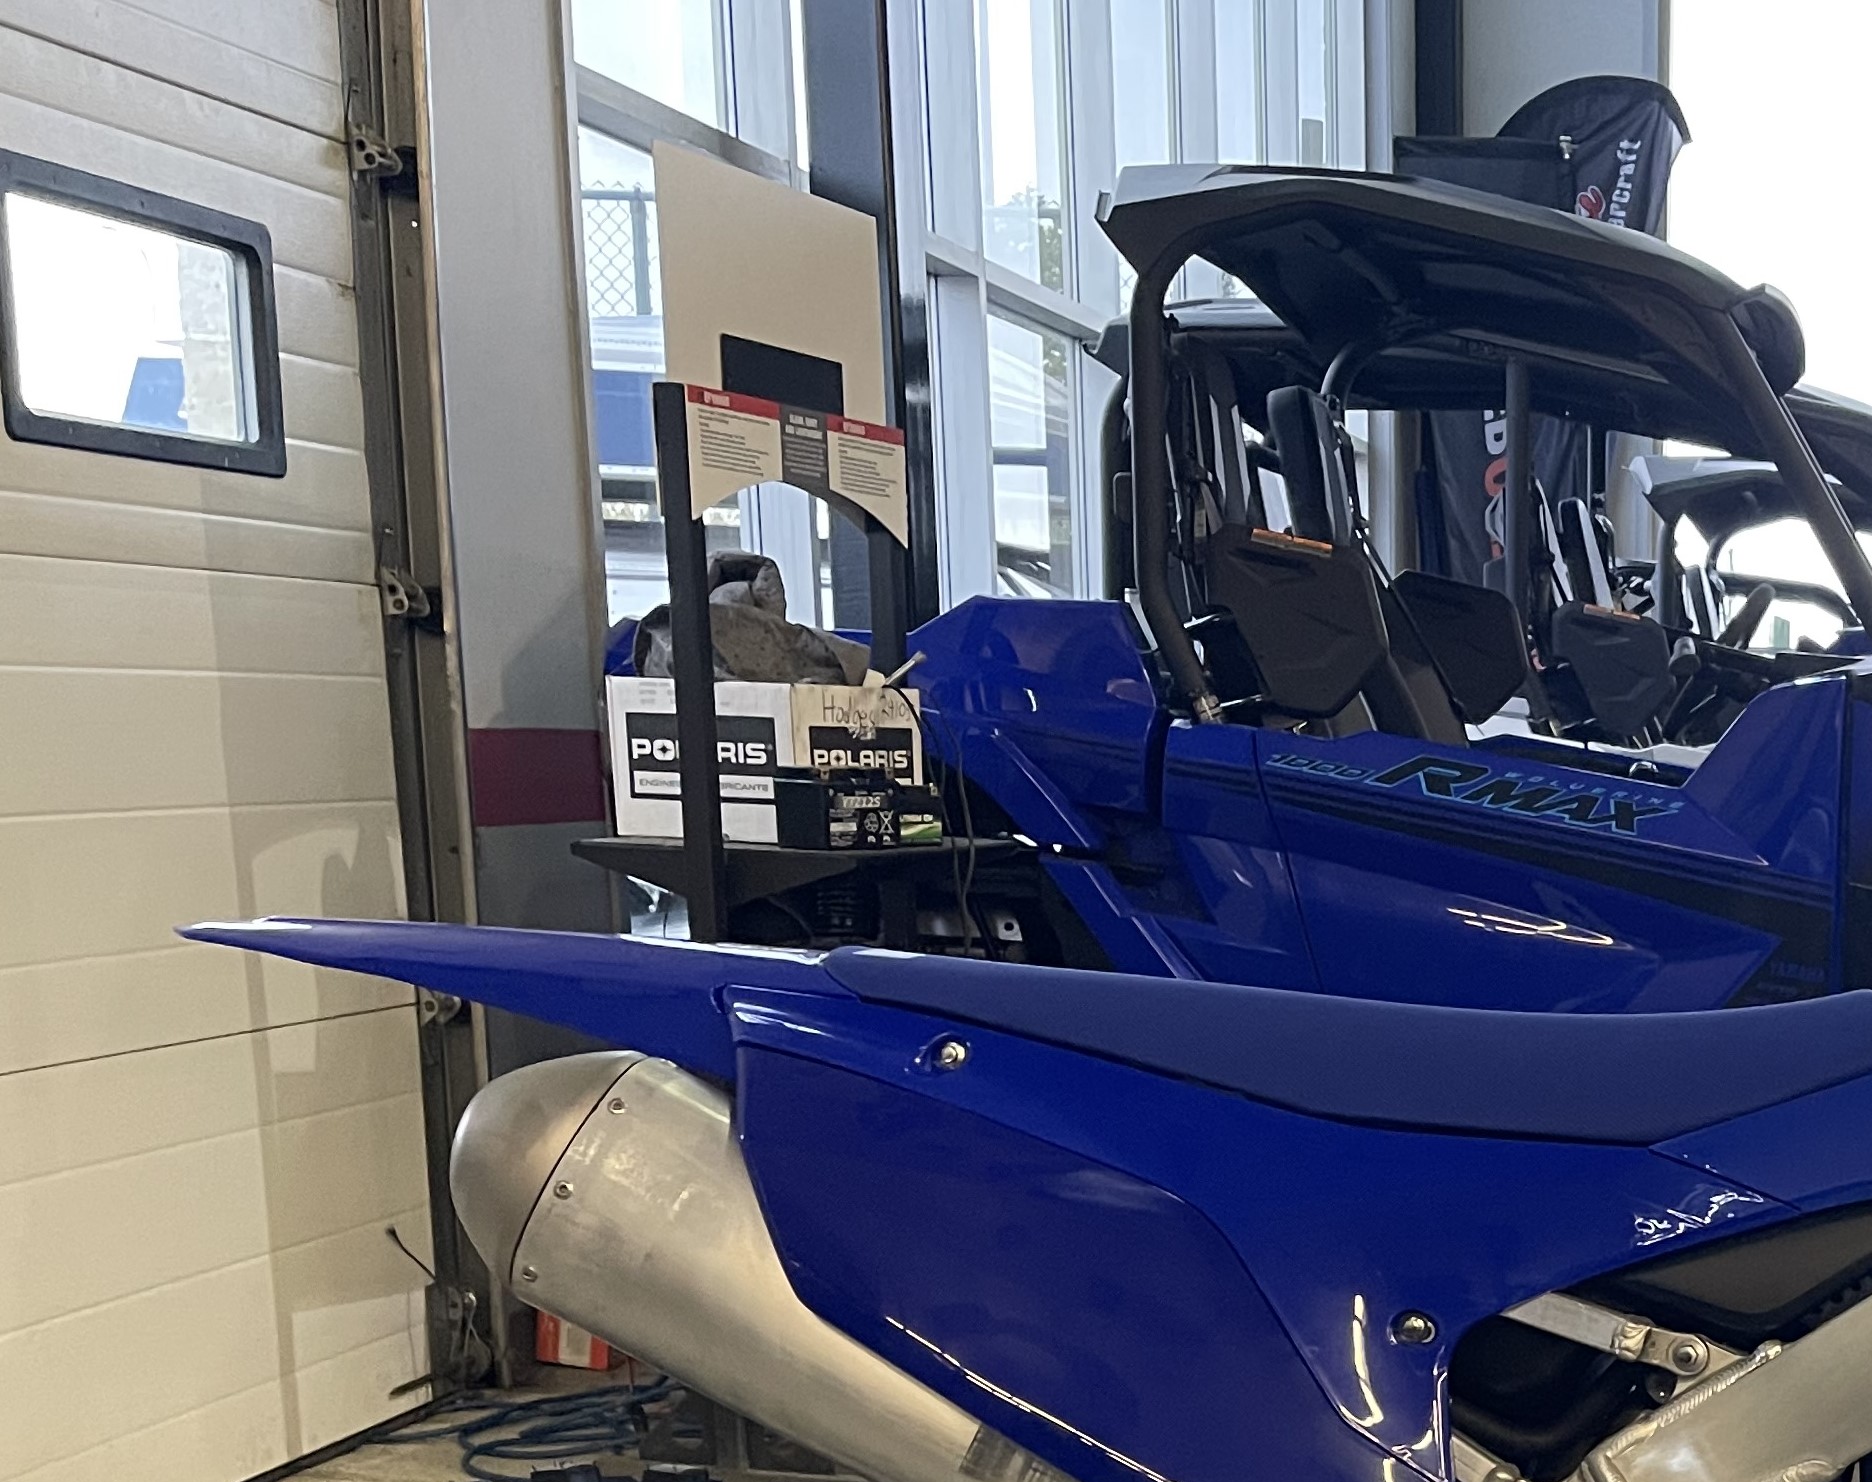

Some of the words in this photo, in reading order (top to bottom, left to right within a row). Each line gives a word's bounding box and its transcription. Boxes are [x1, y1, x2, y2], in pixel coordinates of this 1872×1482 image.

[631, 738, 767, 766] PORIS
[814, 749, 908, 768] POLARIS
[1364, 755, 1680, 836] RMAX
